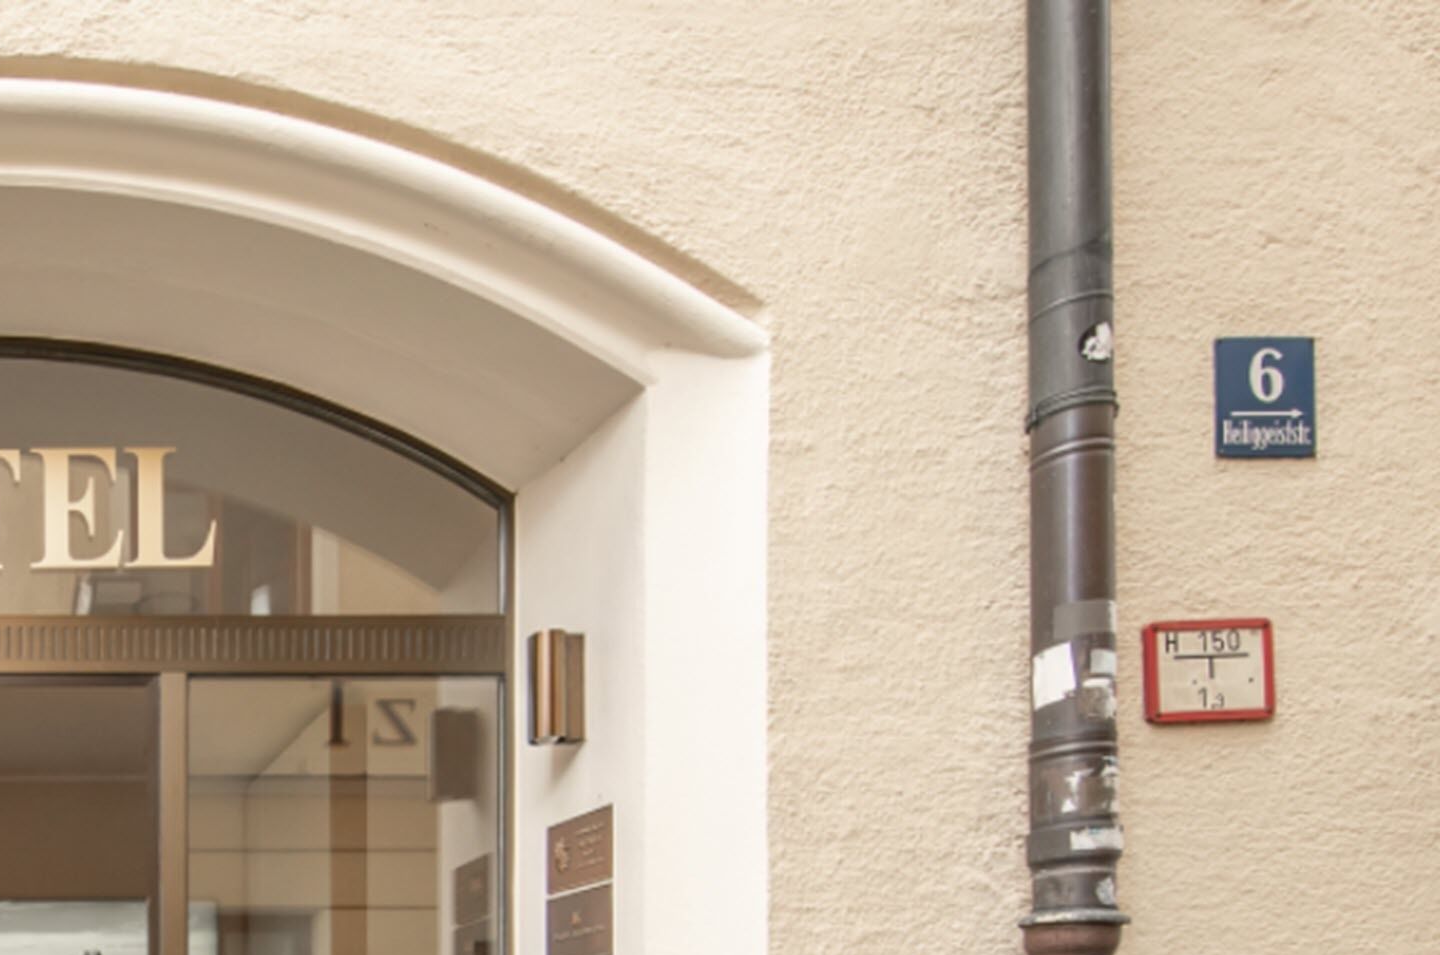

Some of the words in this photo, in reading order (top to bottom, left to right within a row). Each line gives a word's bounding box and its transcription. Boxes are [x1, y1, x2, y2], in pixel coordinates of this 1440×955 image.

[1248, 347, 1284, 403] 6
[1164, 631, 1179, 654] H
[1198, 629, 1241, 653] 150
